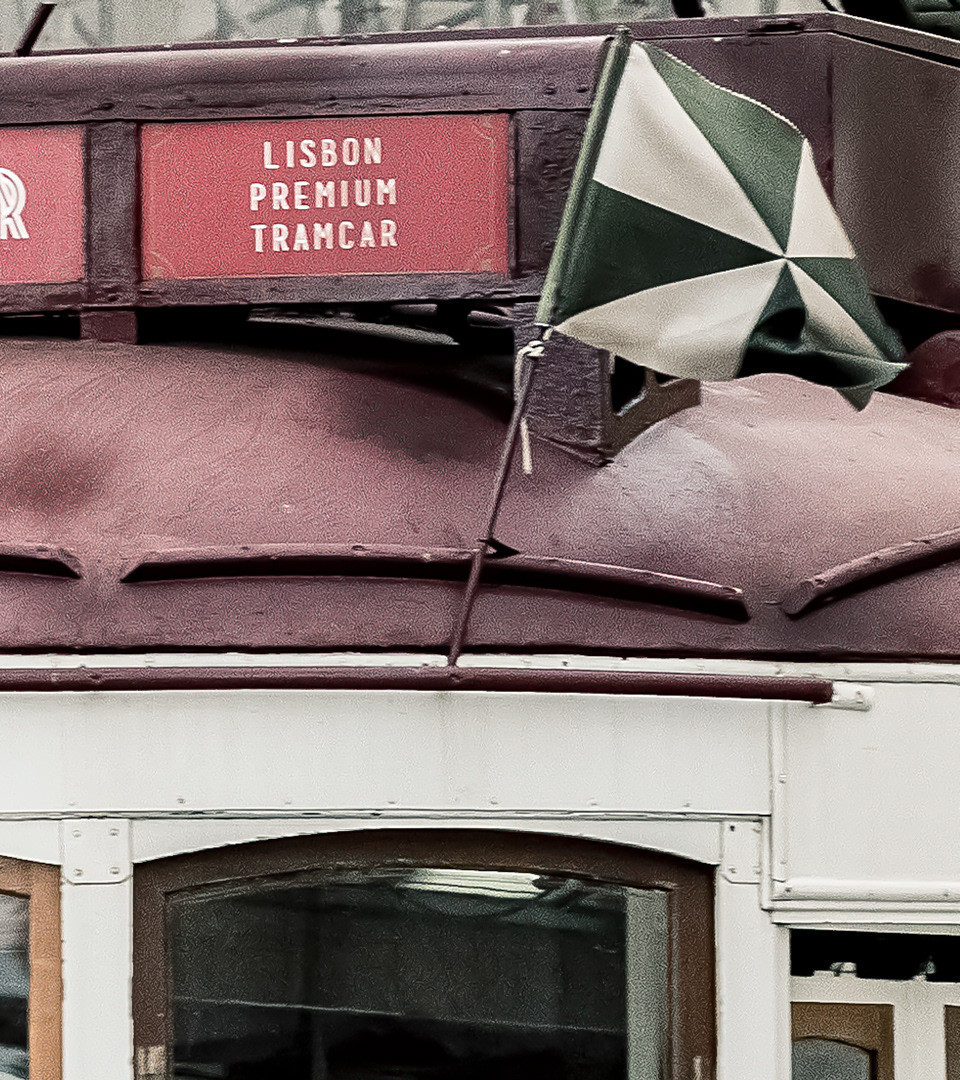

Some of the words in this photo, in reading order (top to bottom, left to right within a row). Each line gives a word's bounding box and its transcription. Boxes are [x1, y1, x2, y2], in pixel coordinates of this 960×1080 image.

[263, 137, 382, 169] LISBON
[250, 178, 397, 211] PREMIUM
[250, 219, 398, 252] TRAMCAR
